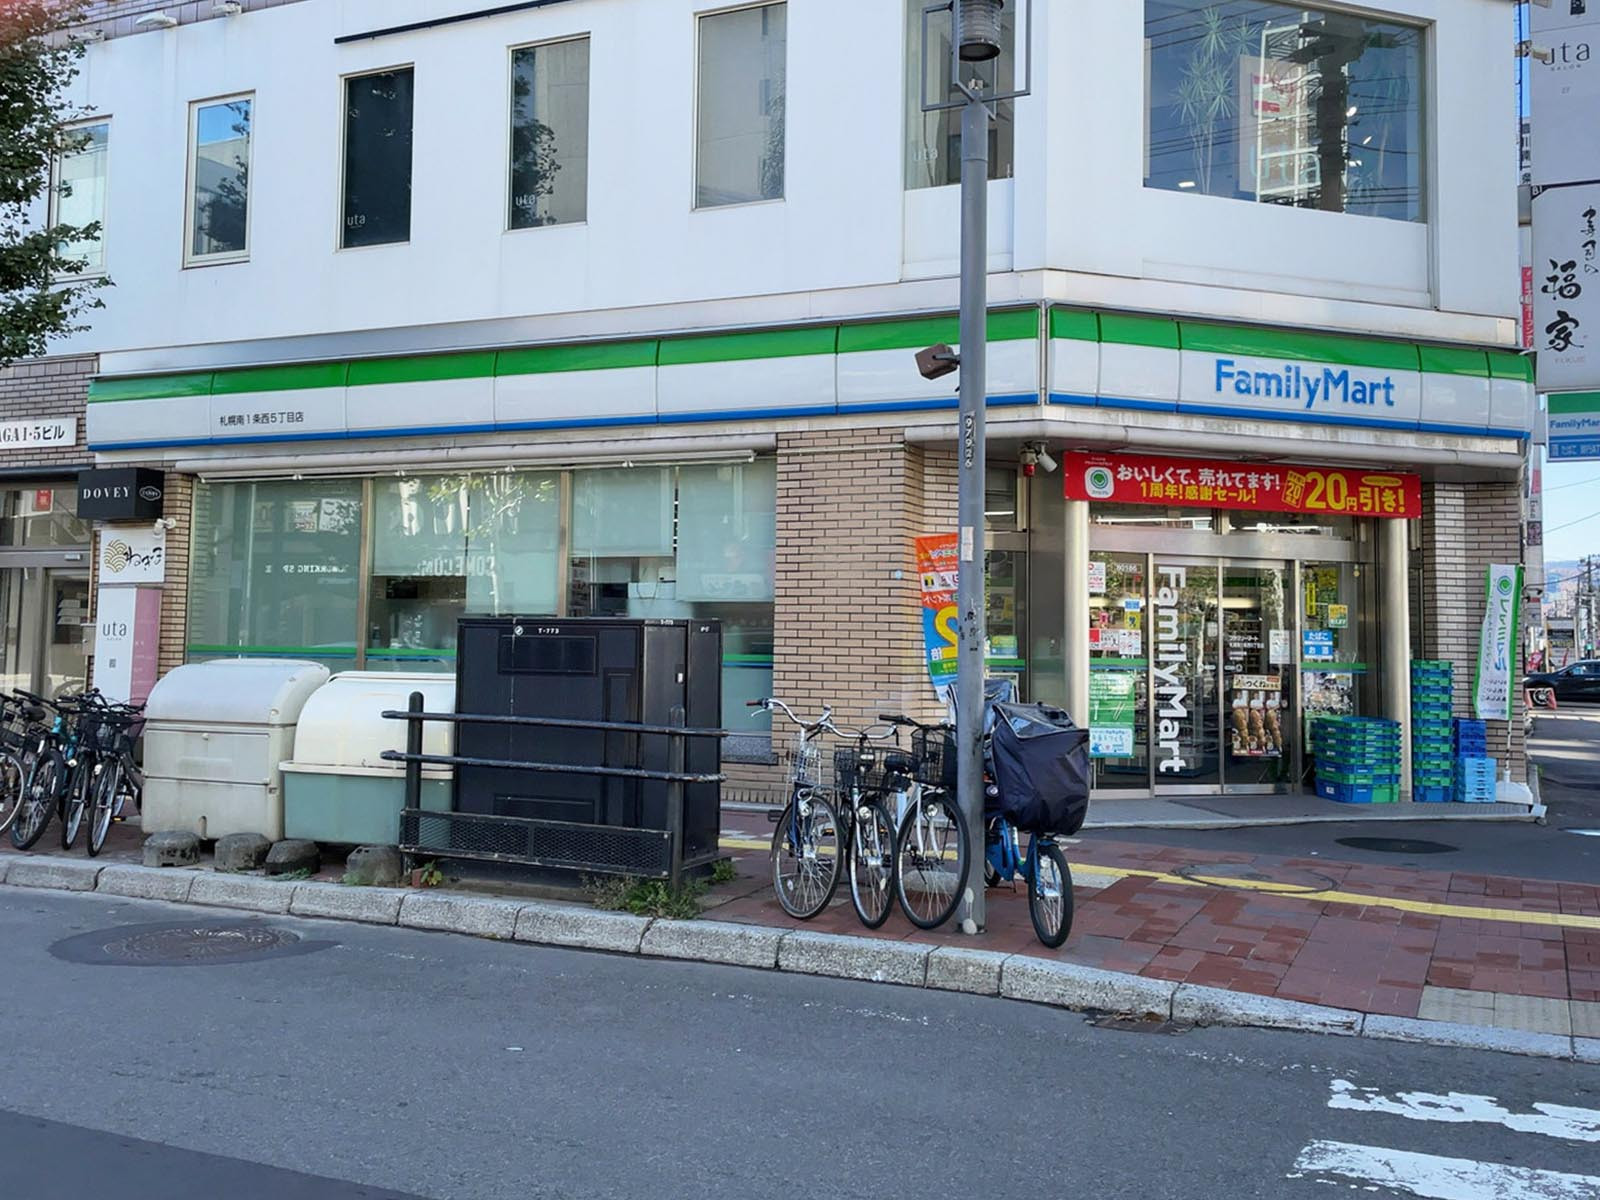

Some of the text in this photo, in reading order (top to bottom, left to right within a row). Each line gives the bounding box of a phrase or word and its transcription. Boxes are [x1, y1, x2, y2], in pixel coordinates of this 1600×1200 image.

[347, 214, 366, 226] uta
[1541, 258, 1584, 352] 福家
[1215, 358, 1395, 410] FamilyMart
[1549, 418, 1600, 430] FamilyMar
[83, 486, 131, 499] DOVEY
[102, 621, 127, 636] uta
[1154, 566, 1188, 773] FamilyMart
